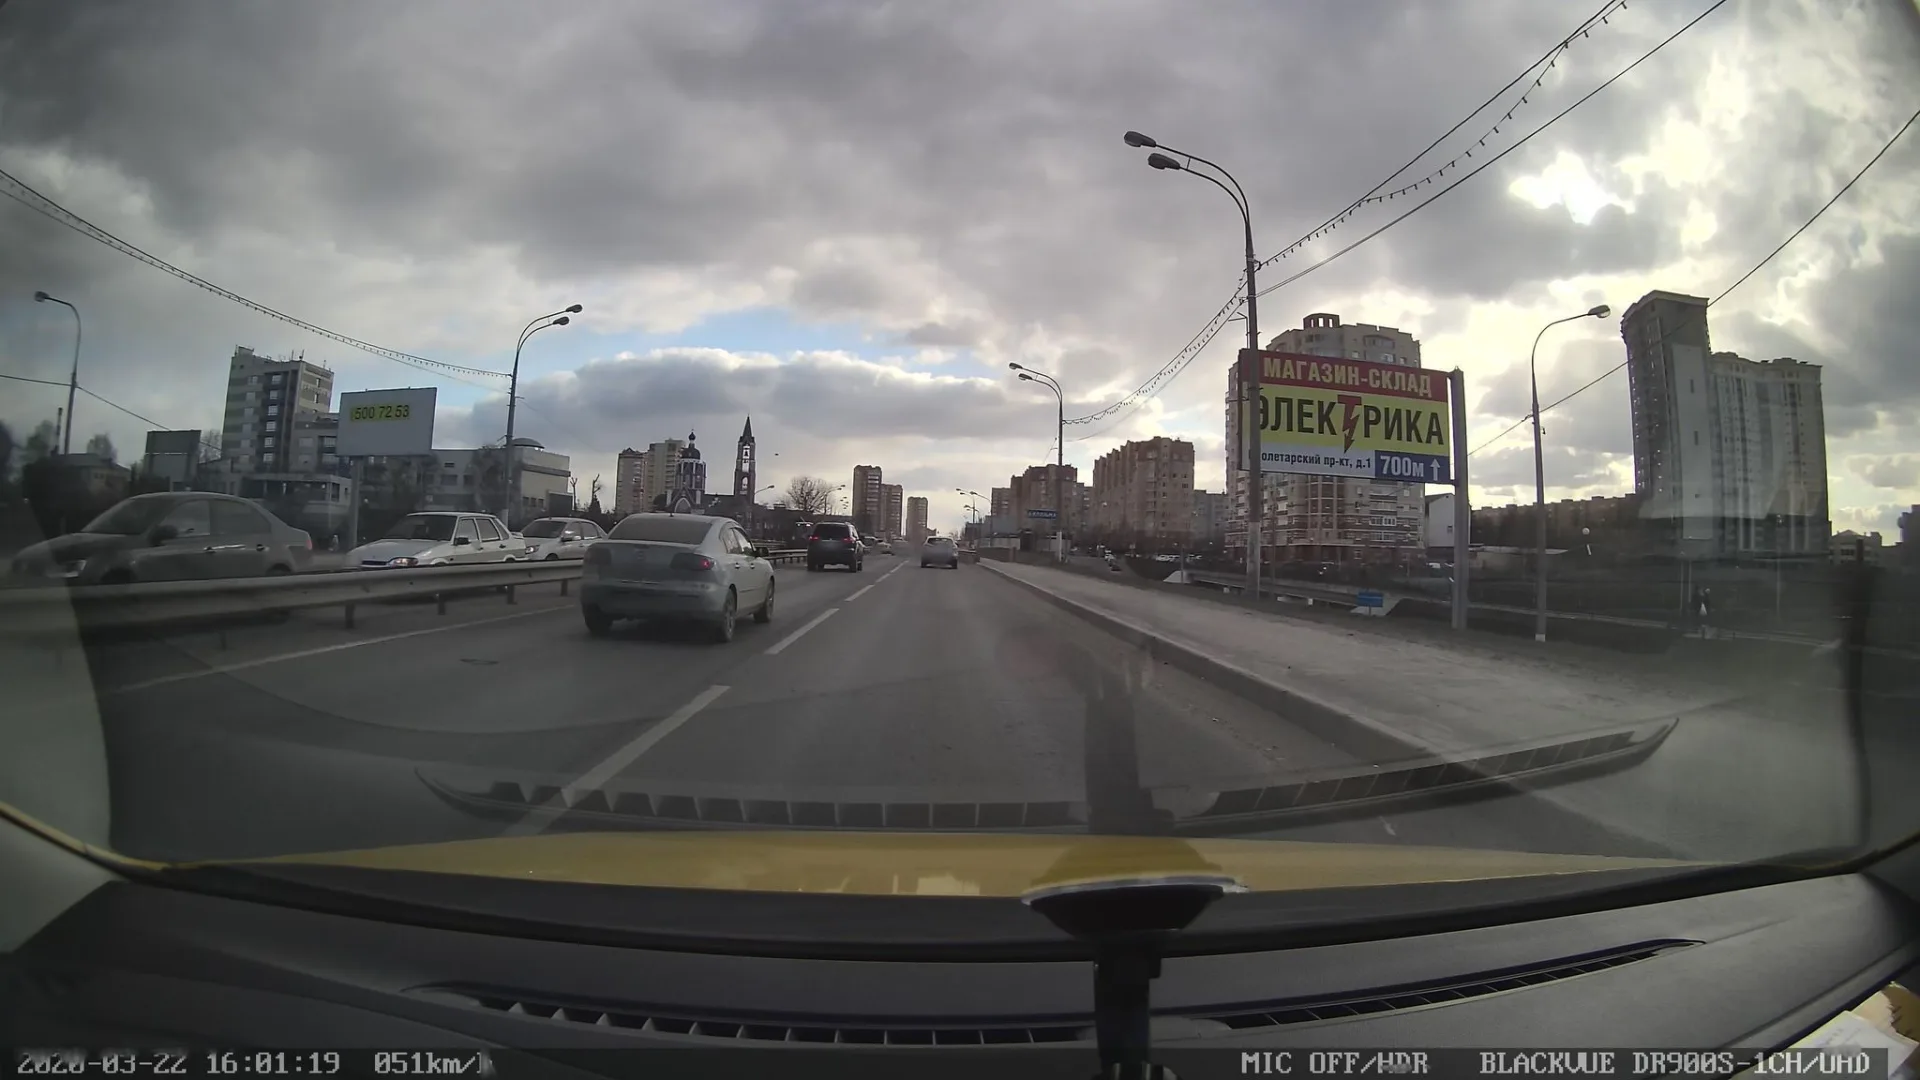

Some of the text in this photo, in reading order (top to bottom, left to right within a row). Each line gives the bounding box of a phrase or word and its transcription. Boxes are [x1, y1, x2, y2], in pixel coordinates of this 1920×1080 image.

[1264, 357, 1432, 398] МАГАЗИН-СКЛАД
[379, 405, 392, 418] 72
[1260, 450, 1371, 470] олетарский пр-кт, д.1
[1380, 455, 1424, 477] 700м
